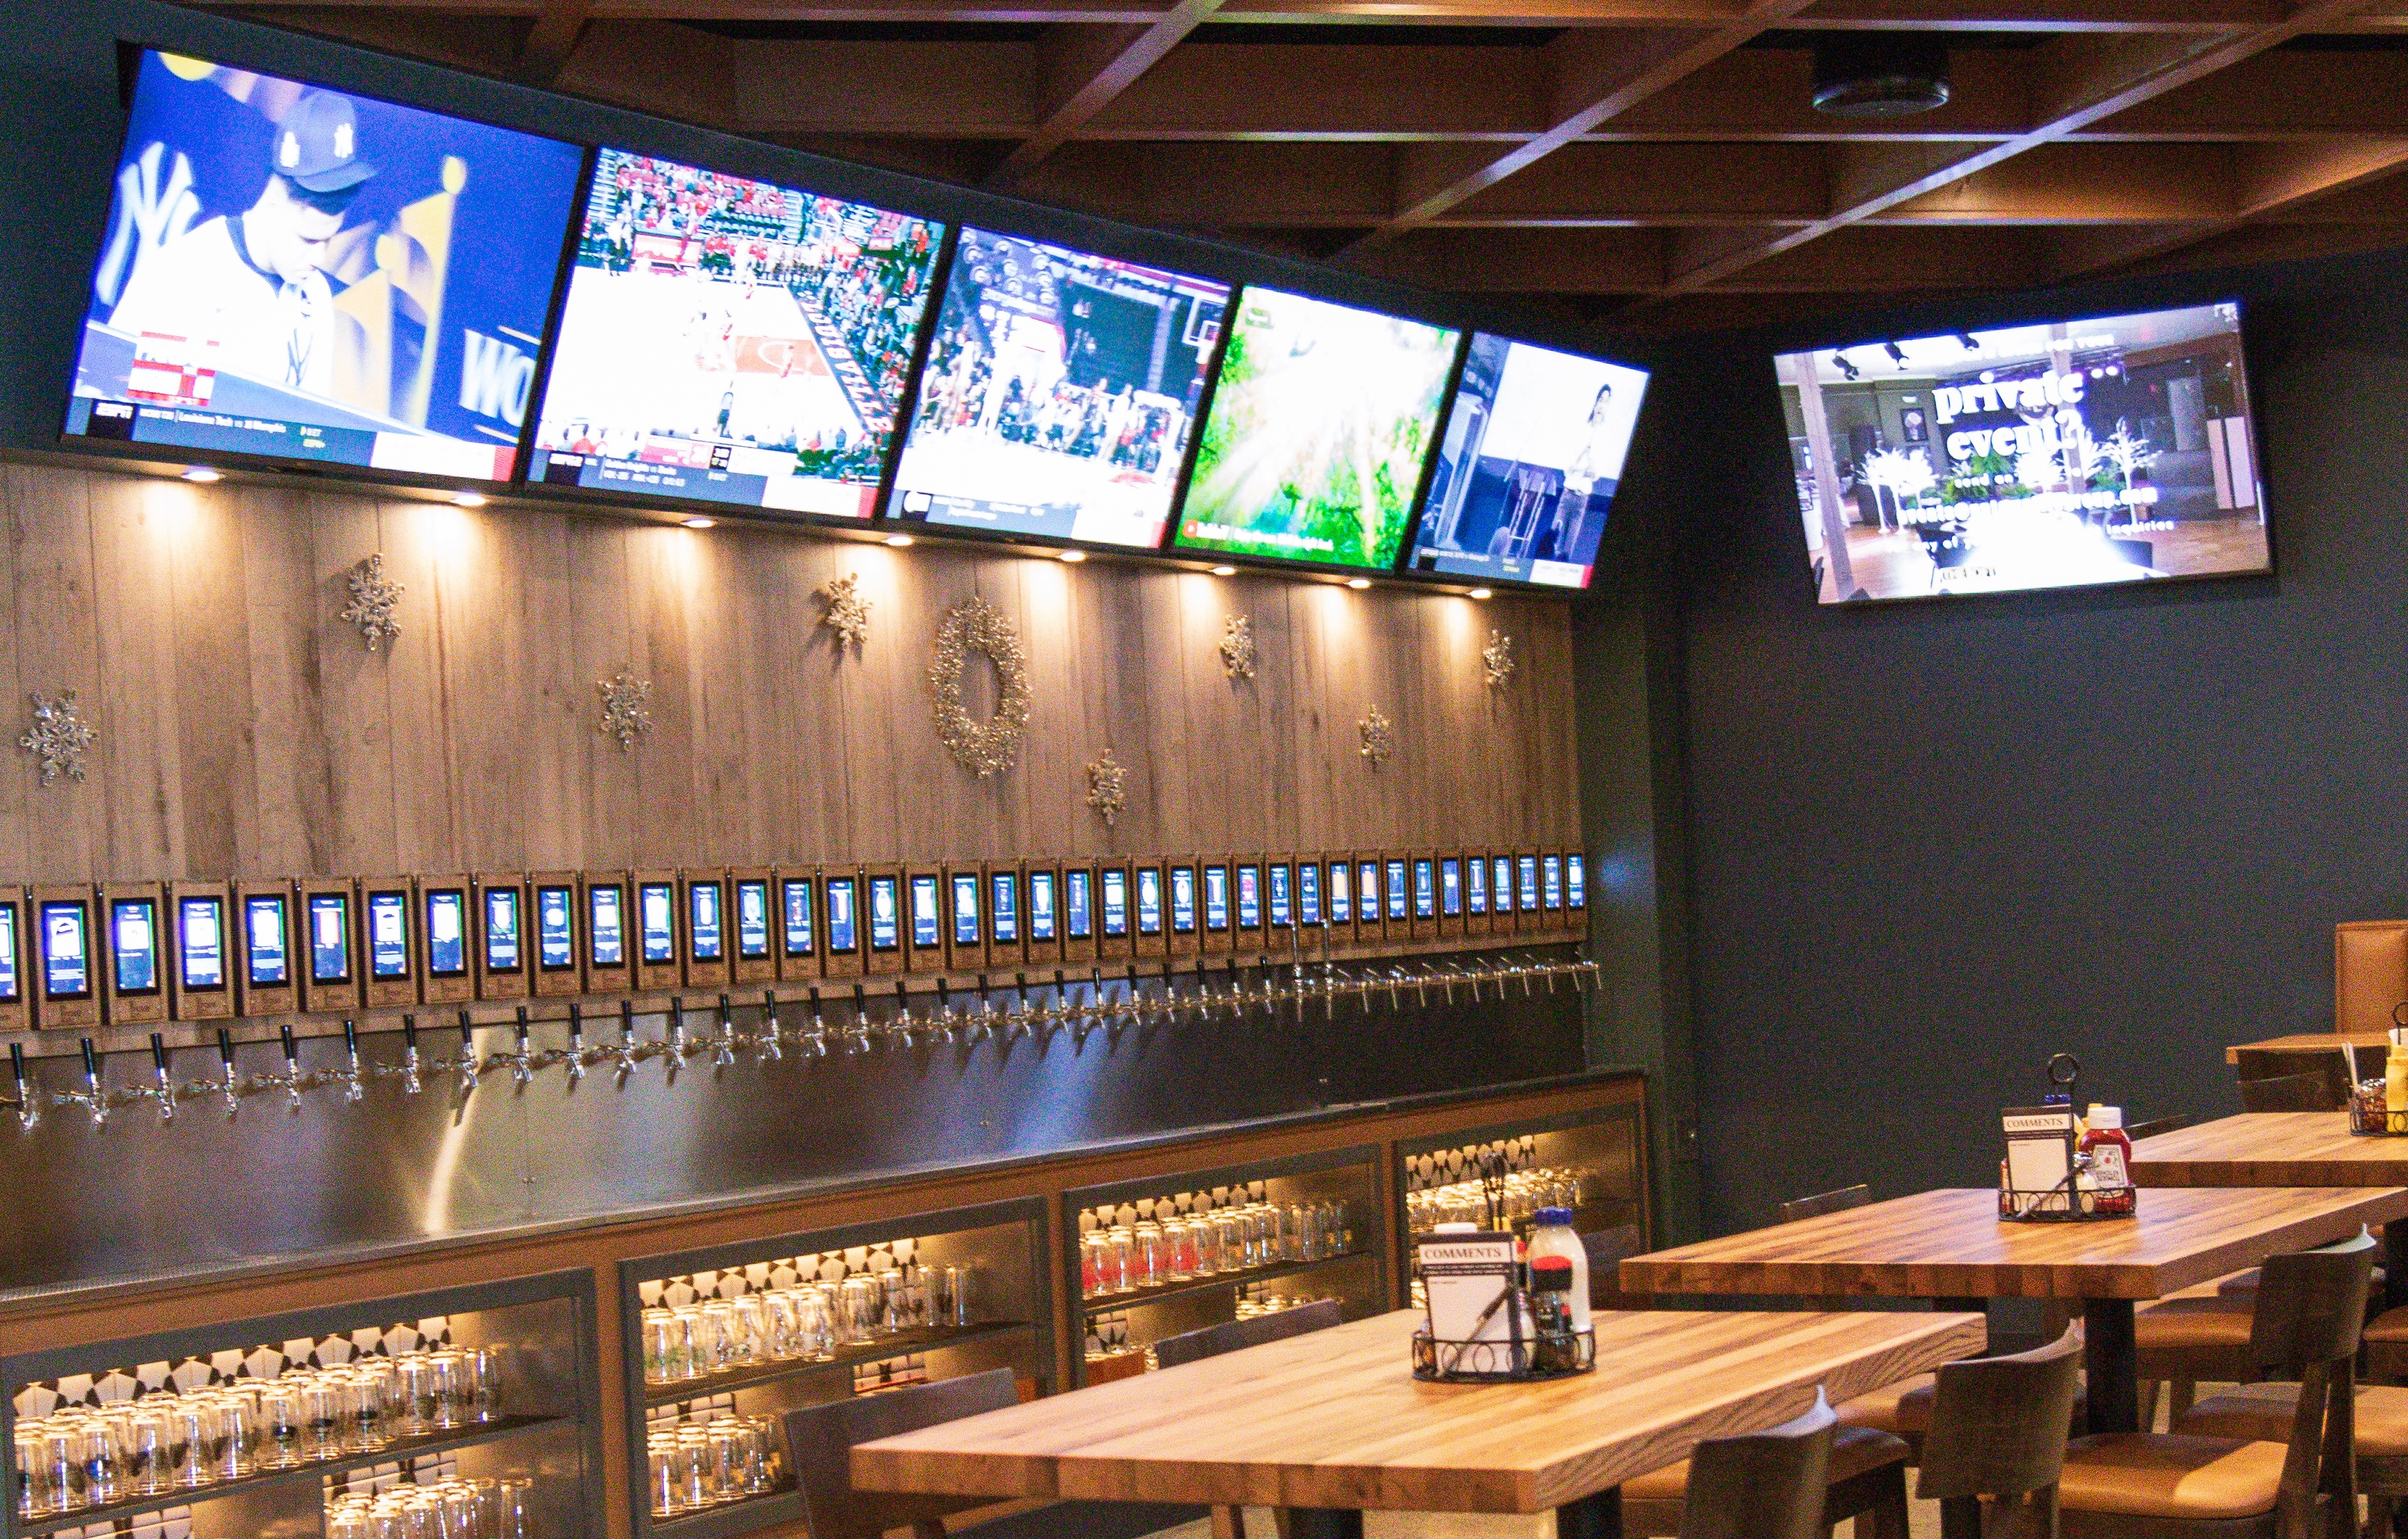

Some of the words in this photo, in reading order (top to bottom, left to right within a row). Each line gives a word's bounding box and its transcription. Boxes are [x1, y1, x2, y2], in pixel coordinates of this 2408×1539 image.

[1933, 371, 2085, 424] private
[1947, 409, 2083, 461] event?
[2006, 1117, 2064, 1129] COMMENTS
[1424, 1247, 1502, 1260] COMMENTS
